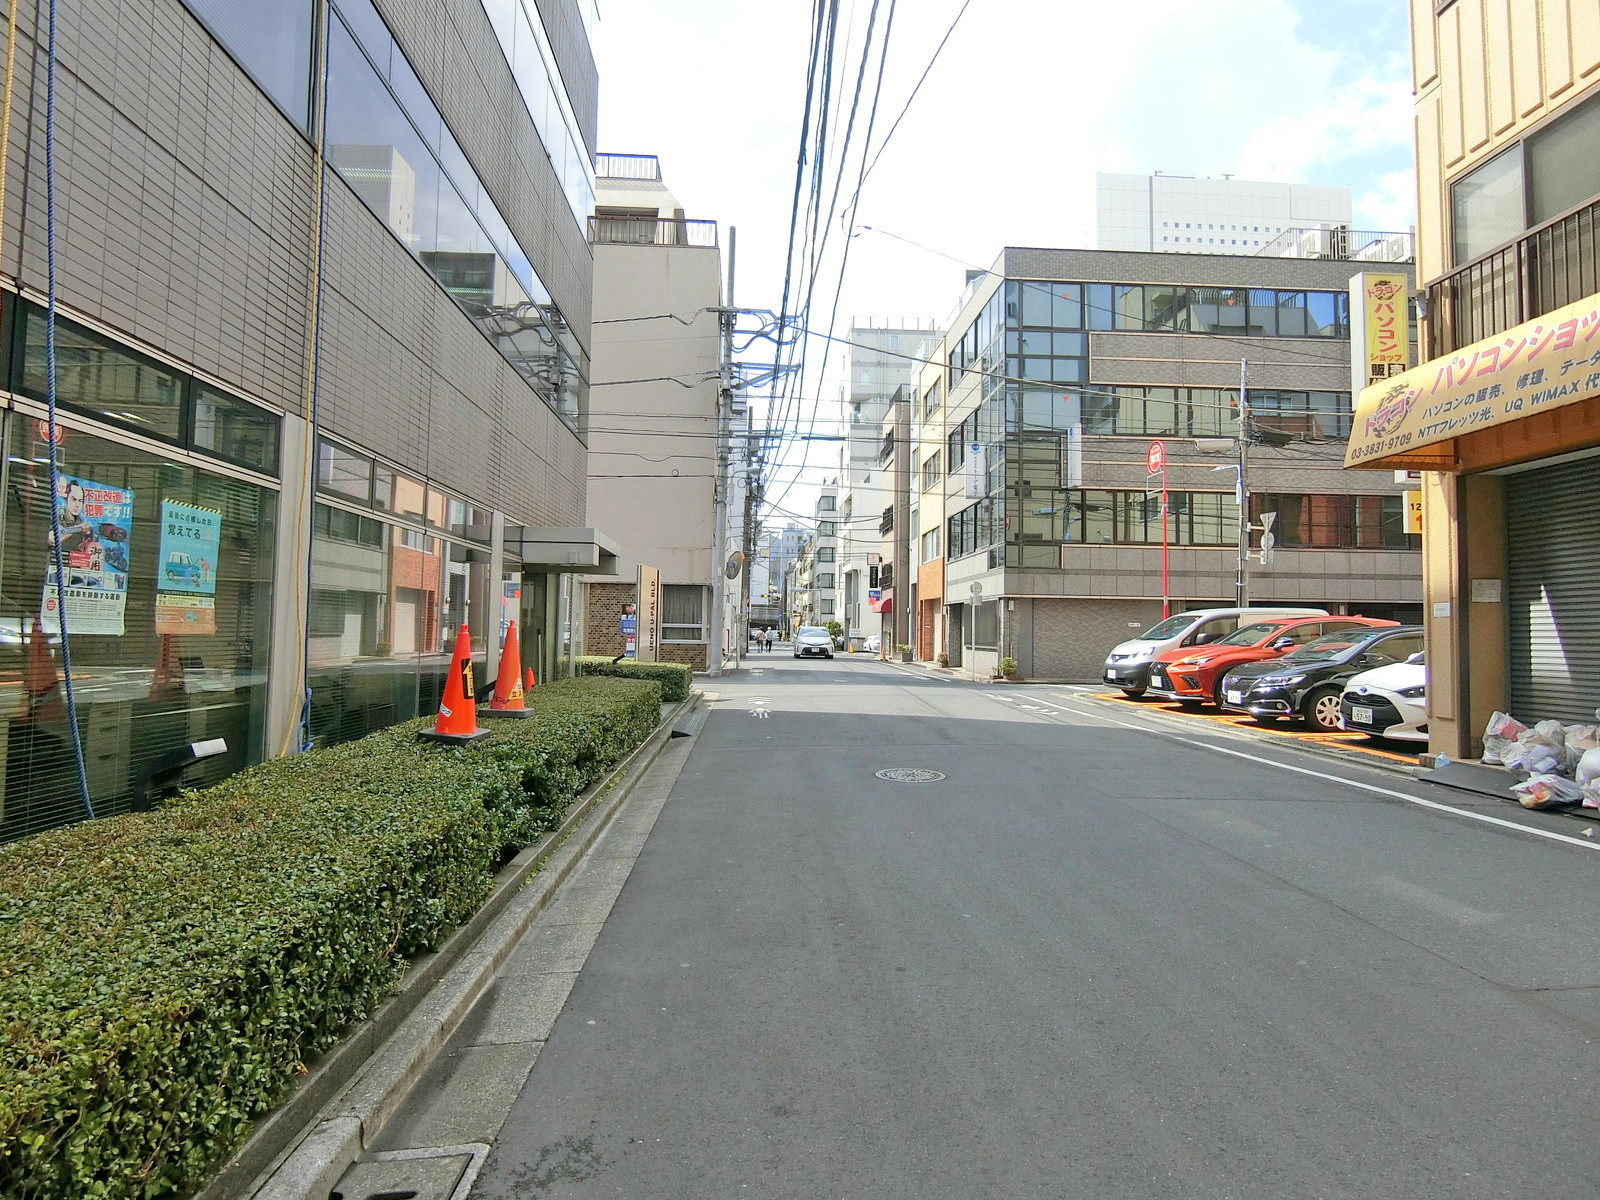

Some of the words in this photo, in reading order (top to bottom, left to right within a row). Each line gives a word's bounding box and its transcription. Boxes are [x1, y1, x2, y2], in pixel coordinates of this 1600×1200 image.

[1374, 302, 1398, 353] パソコン
[1370, 353, 1403, 362] ショップ
[1351, 431, 1412, 460] 03-3831-9709
[1504, 398, 1524, 413] UQ
[1530, 379, 1580, 406] WIMAX
[84, 489, 132, 504] 不正改造は
